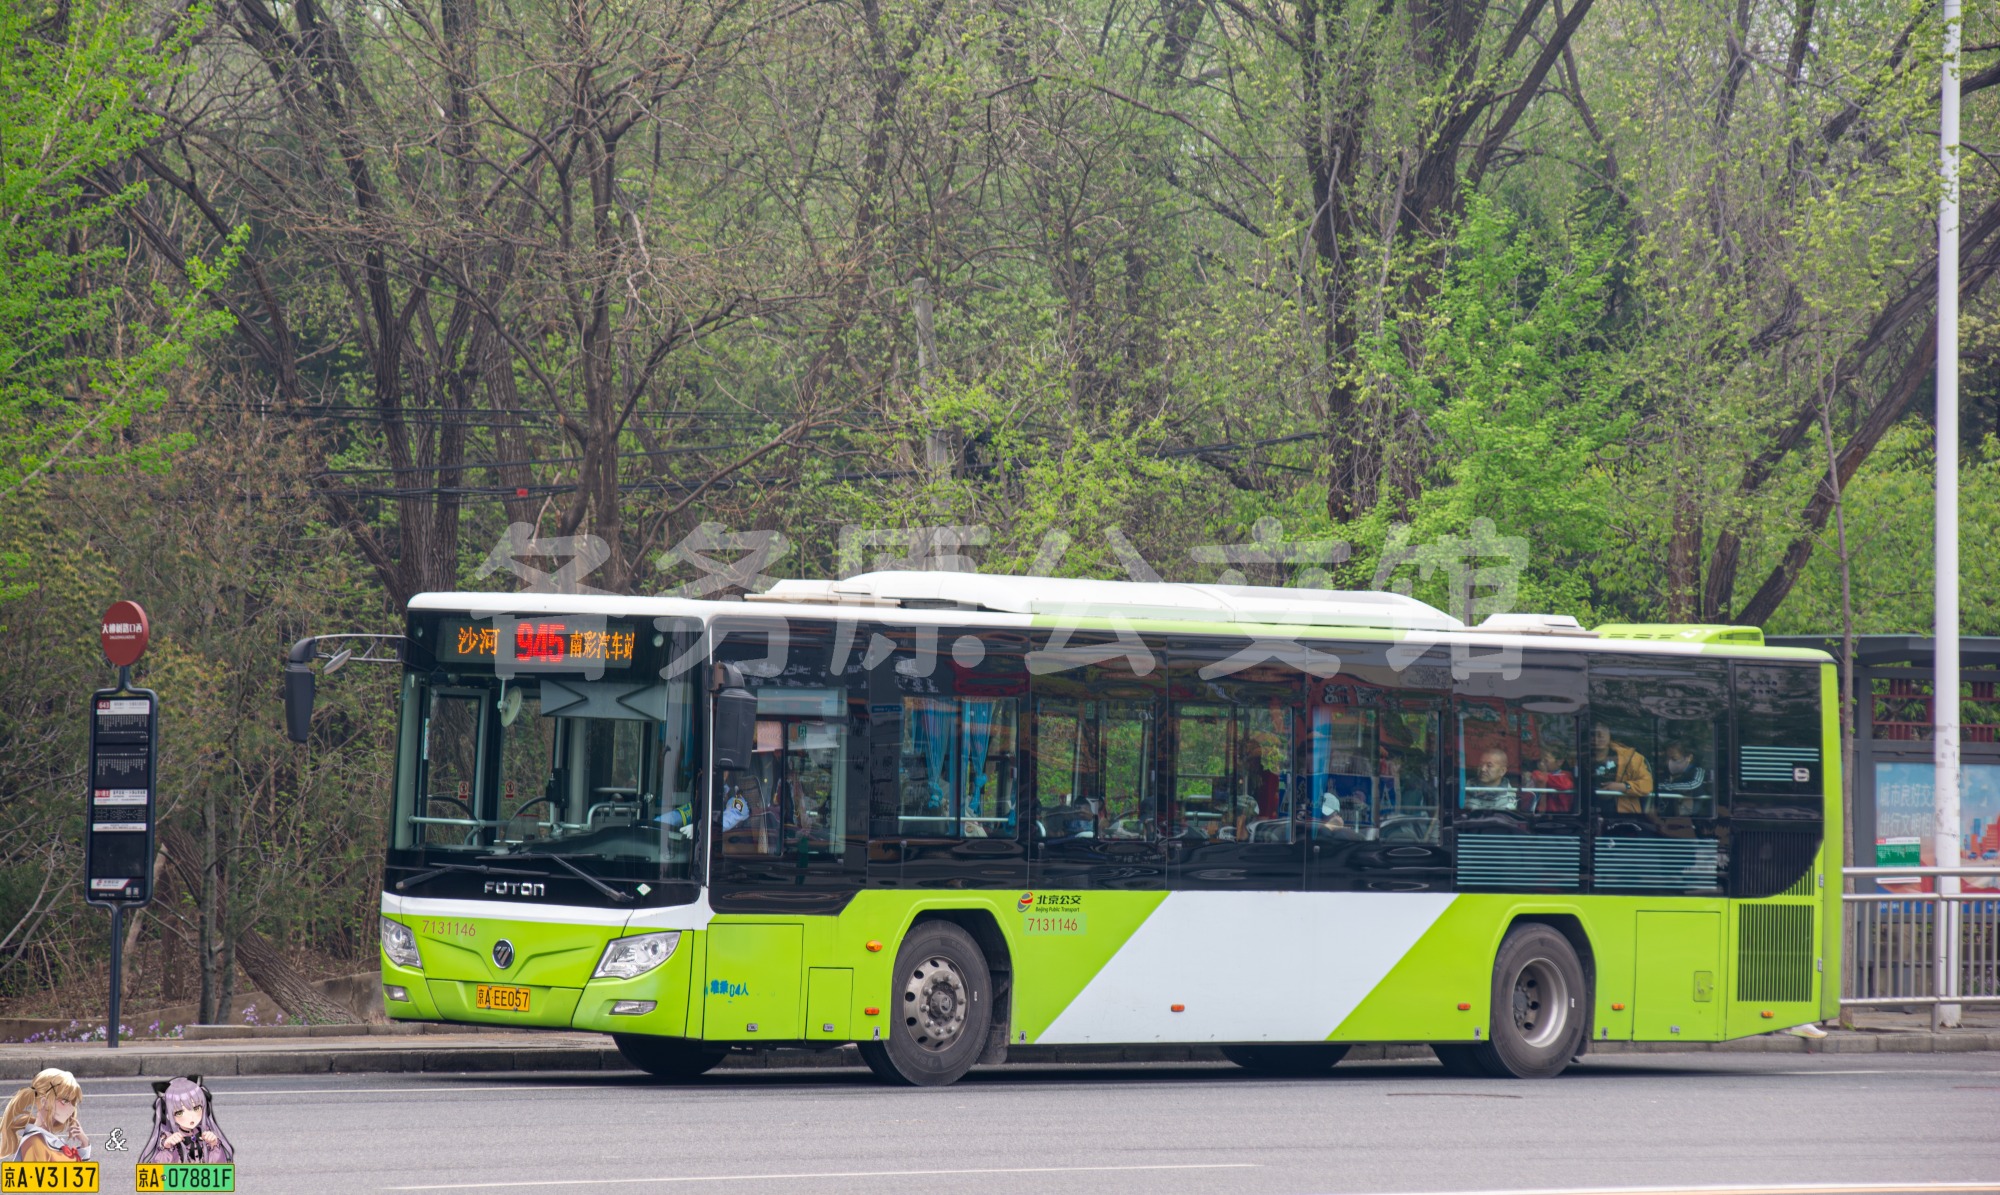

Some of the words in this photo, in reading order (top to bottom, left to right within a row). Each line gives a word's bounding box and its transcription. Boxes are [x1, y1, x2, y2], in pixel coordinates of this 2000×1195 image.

[457, 626, 500, 655] 沙河
[515, 623, 566, 663] 945
[569, 630, 635, 661] 南彩汽车站
[1880, 782, 1936, 807] 城市良好交
[1880, 812, 1936, 837] 出行文明相
[484, 881, 545, 896] FOTON
[1036, 894, 1082, 905] 北京公交
[422, 919, 477, 937] 7131146
[1028, 917, 1078, 932] 7131146
